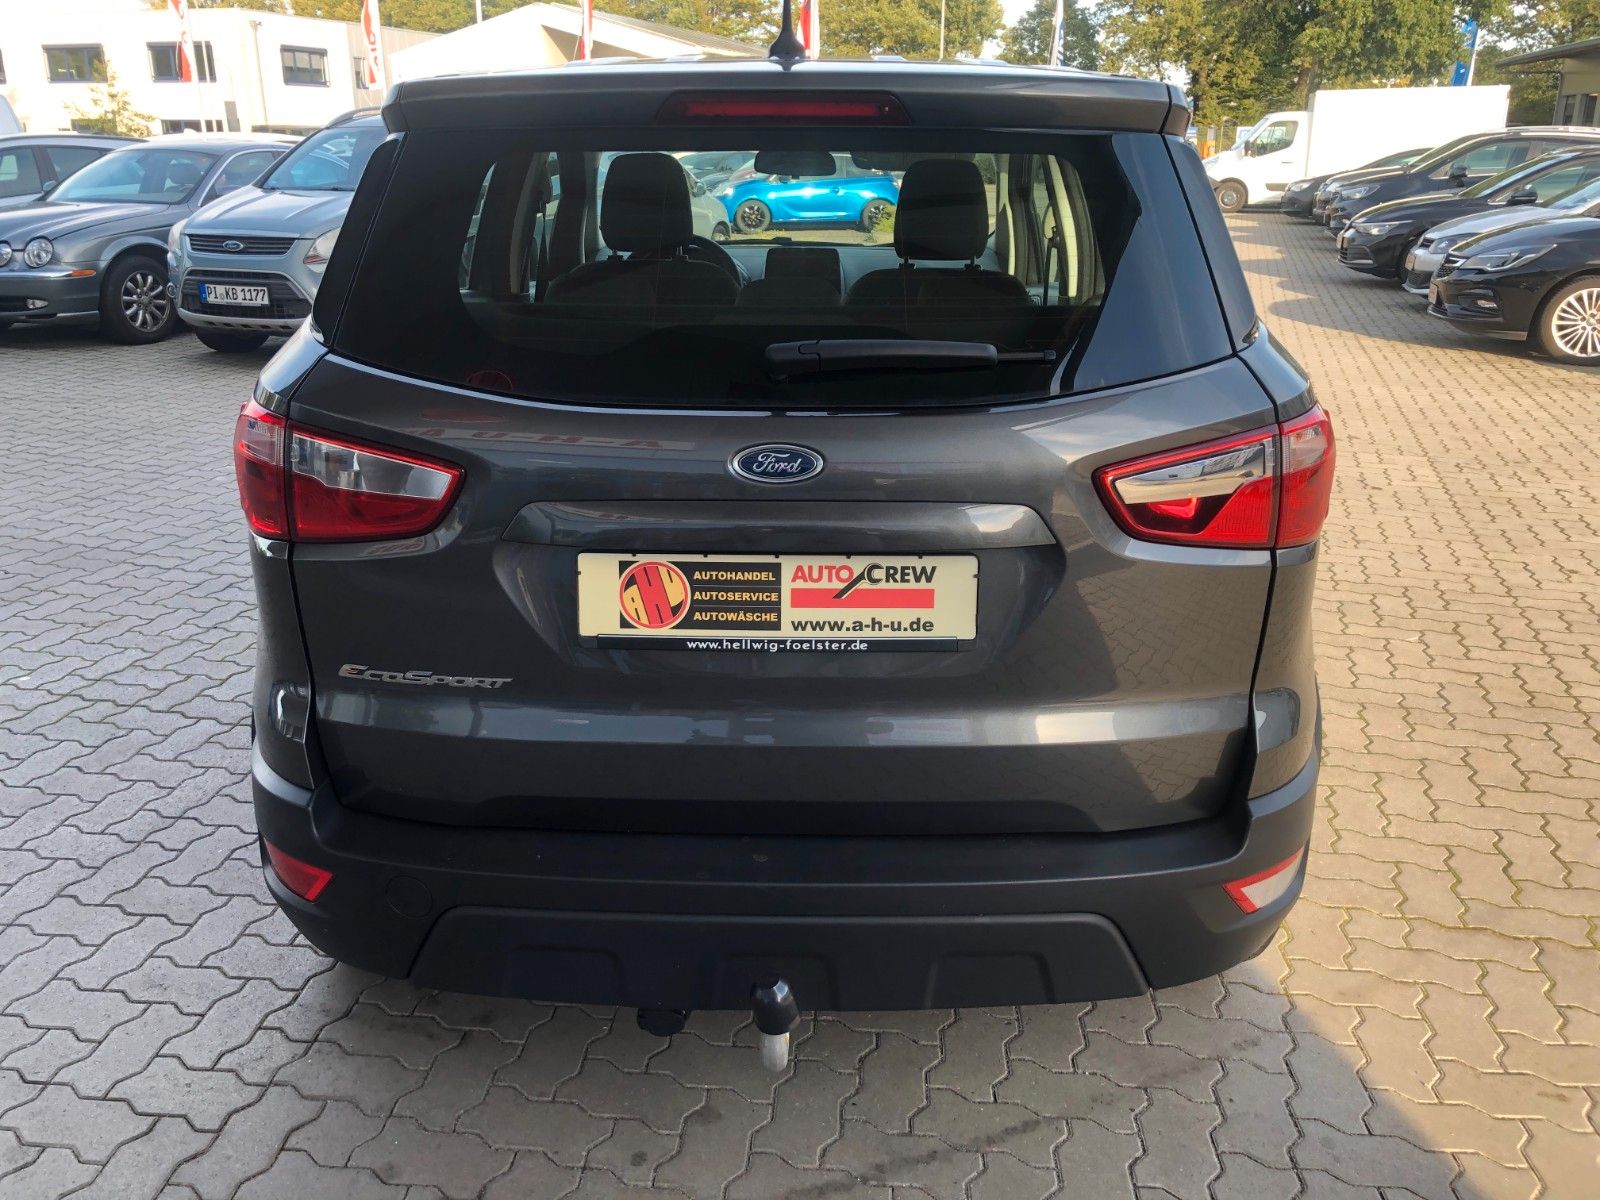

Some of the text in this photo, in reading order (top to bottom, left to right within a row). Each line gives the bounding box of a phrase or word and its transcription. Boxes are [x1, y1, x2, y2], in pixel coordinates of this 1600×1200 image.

[206, 286, 266, 301] PI KB 1177
[753, 452, 802, 473] Ford
[693, 571, 776, 581] AUTOHANDEL
[791, 565, 937, 584] AUTO CREW
[693, 591, 779, 601] AUTOSERVICE
[693, 610, 778, 622] AUTOWÄSCHE
[791, 617, 935, 632] www.a-h-u.de
[686, 639, 868, 652] www.hellwig-foelster.de
